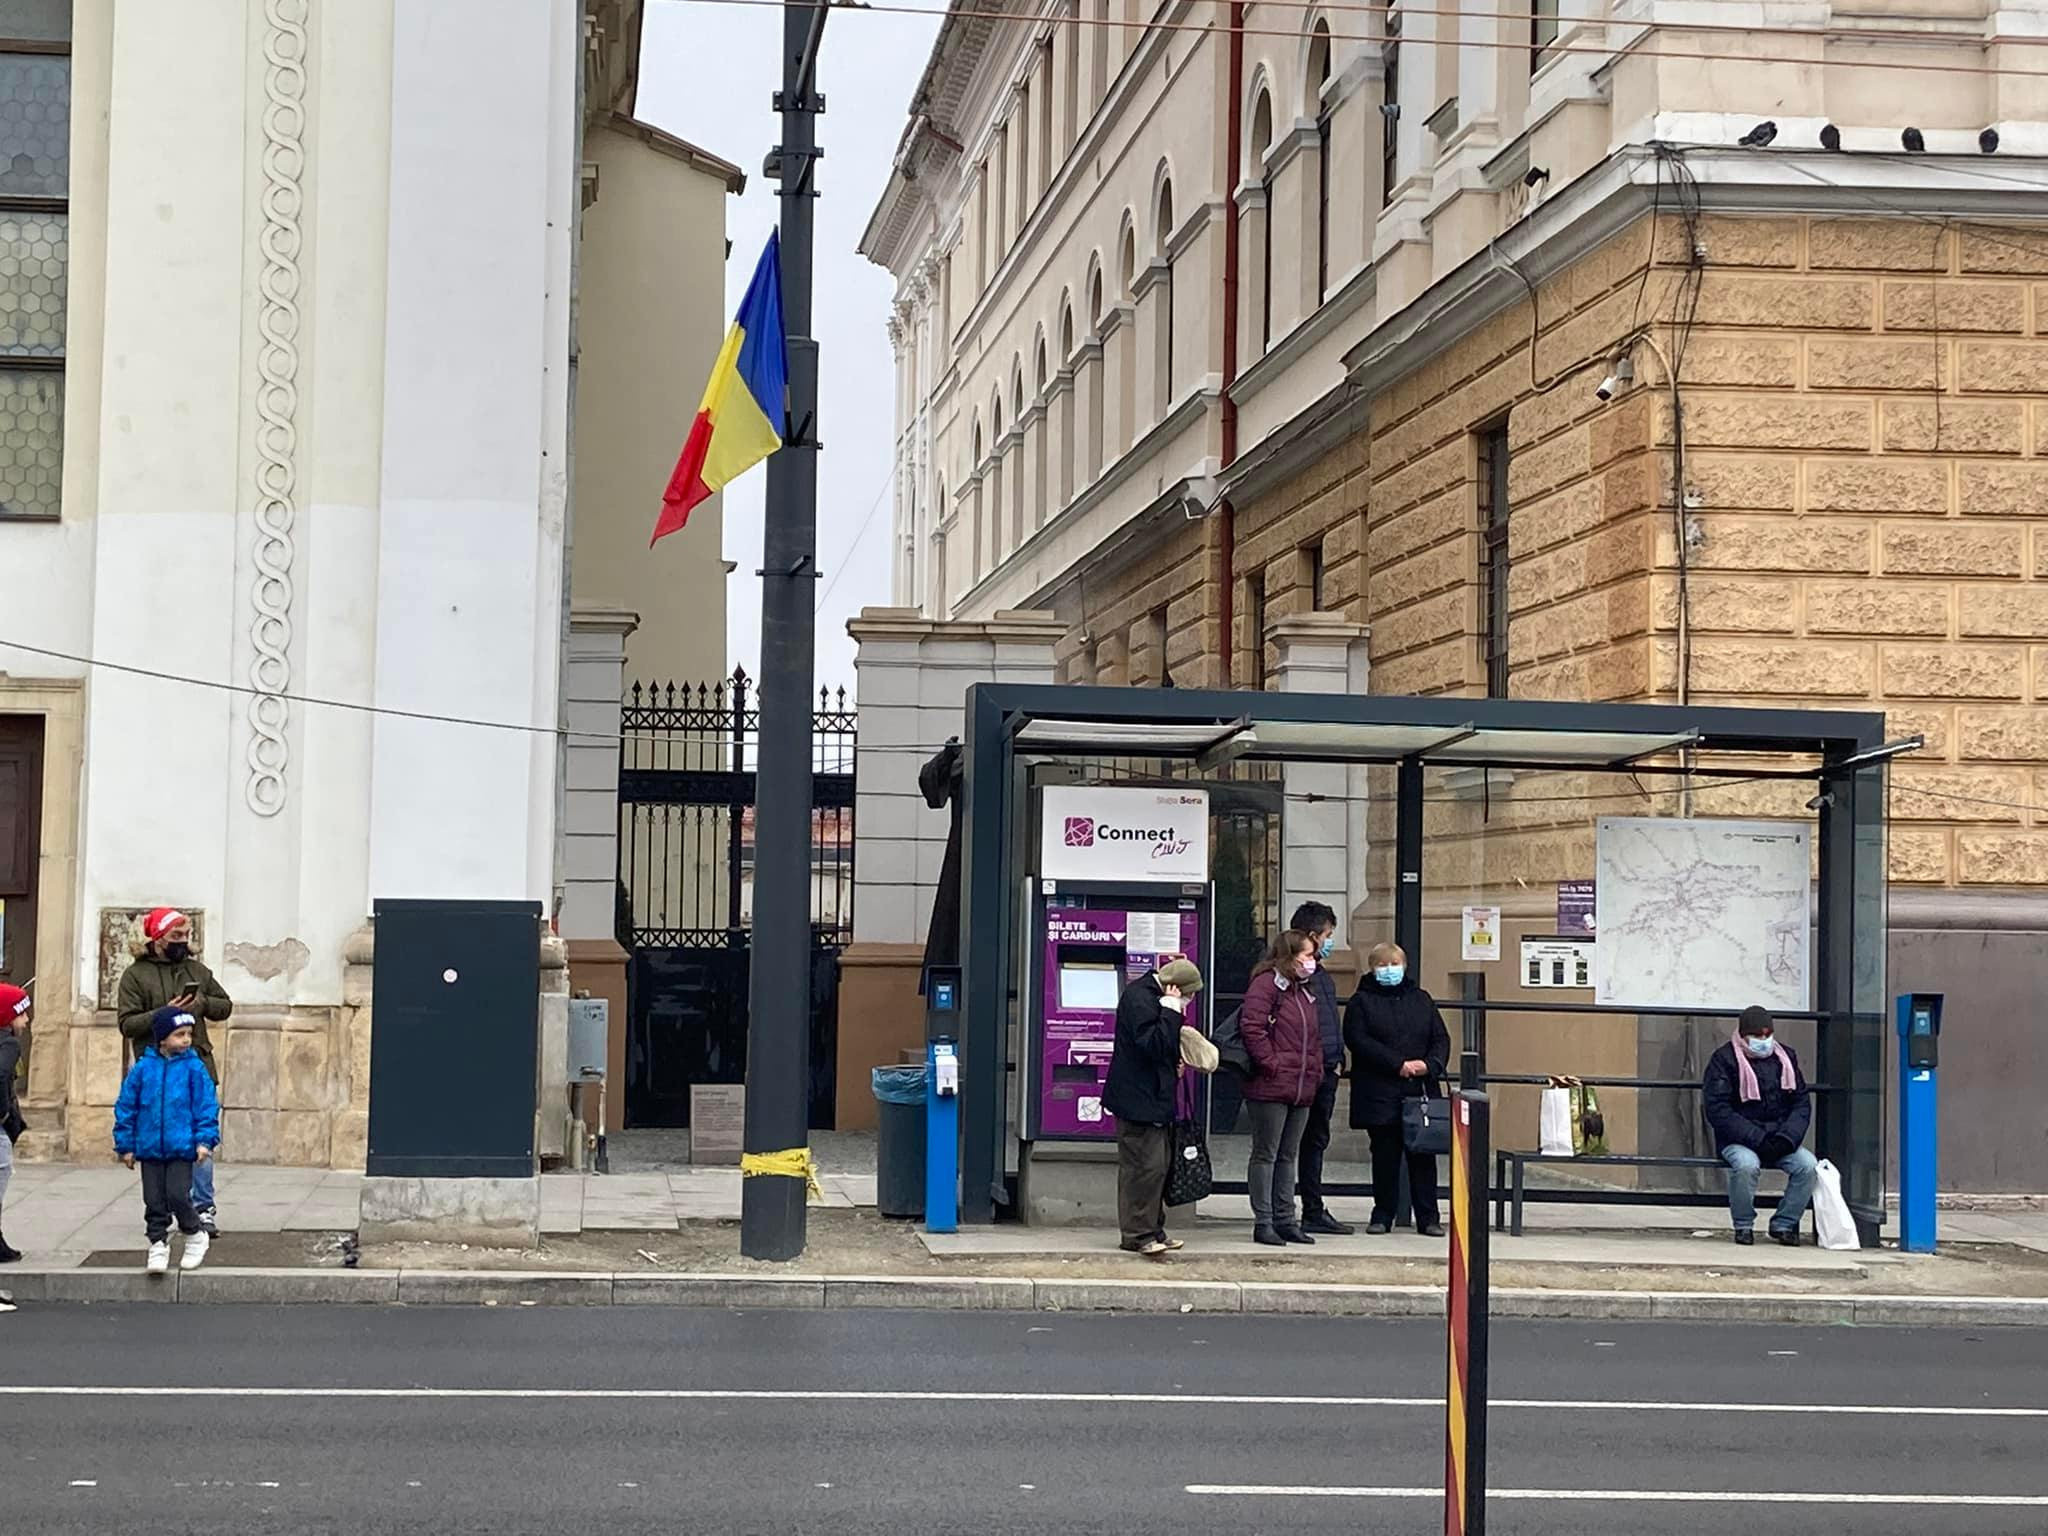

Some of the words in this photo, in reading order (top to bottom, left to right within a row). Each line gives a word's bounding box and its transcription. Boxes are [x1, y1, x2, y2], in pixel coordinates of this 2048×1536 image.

[1097, 824, 1175, 841] Connect
[1048, 921, 1087, 931] BILETE
[1061, 931, 1111, 942] CARDURI
